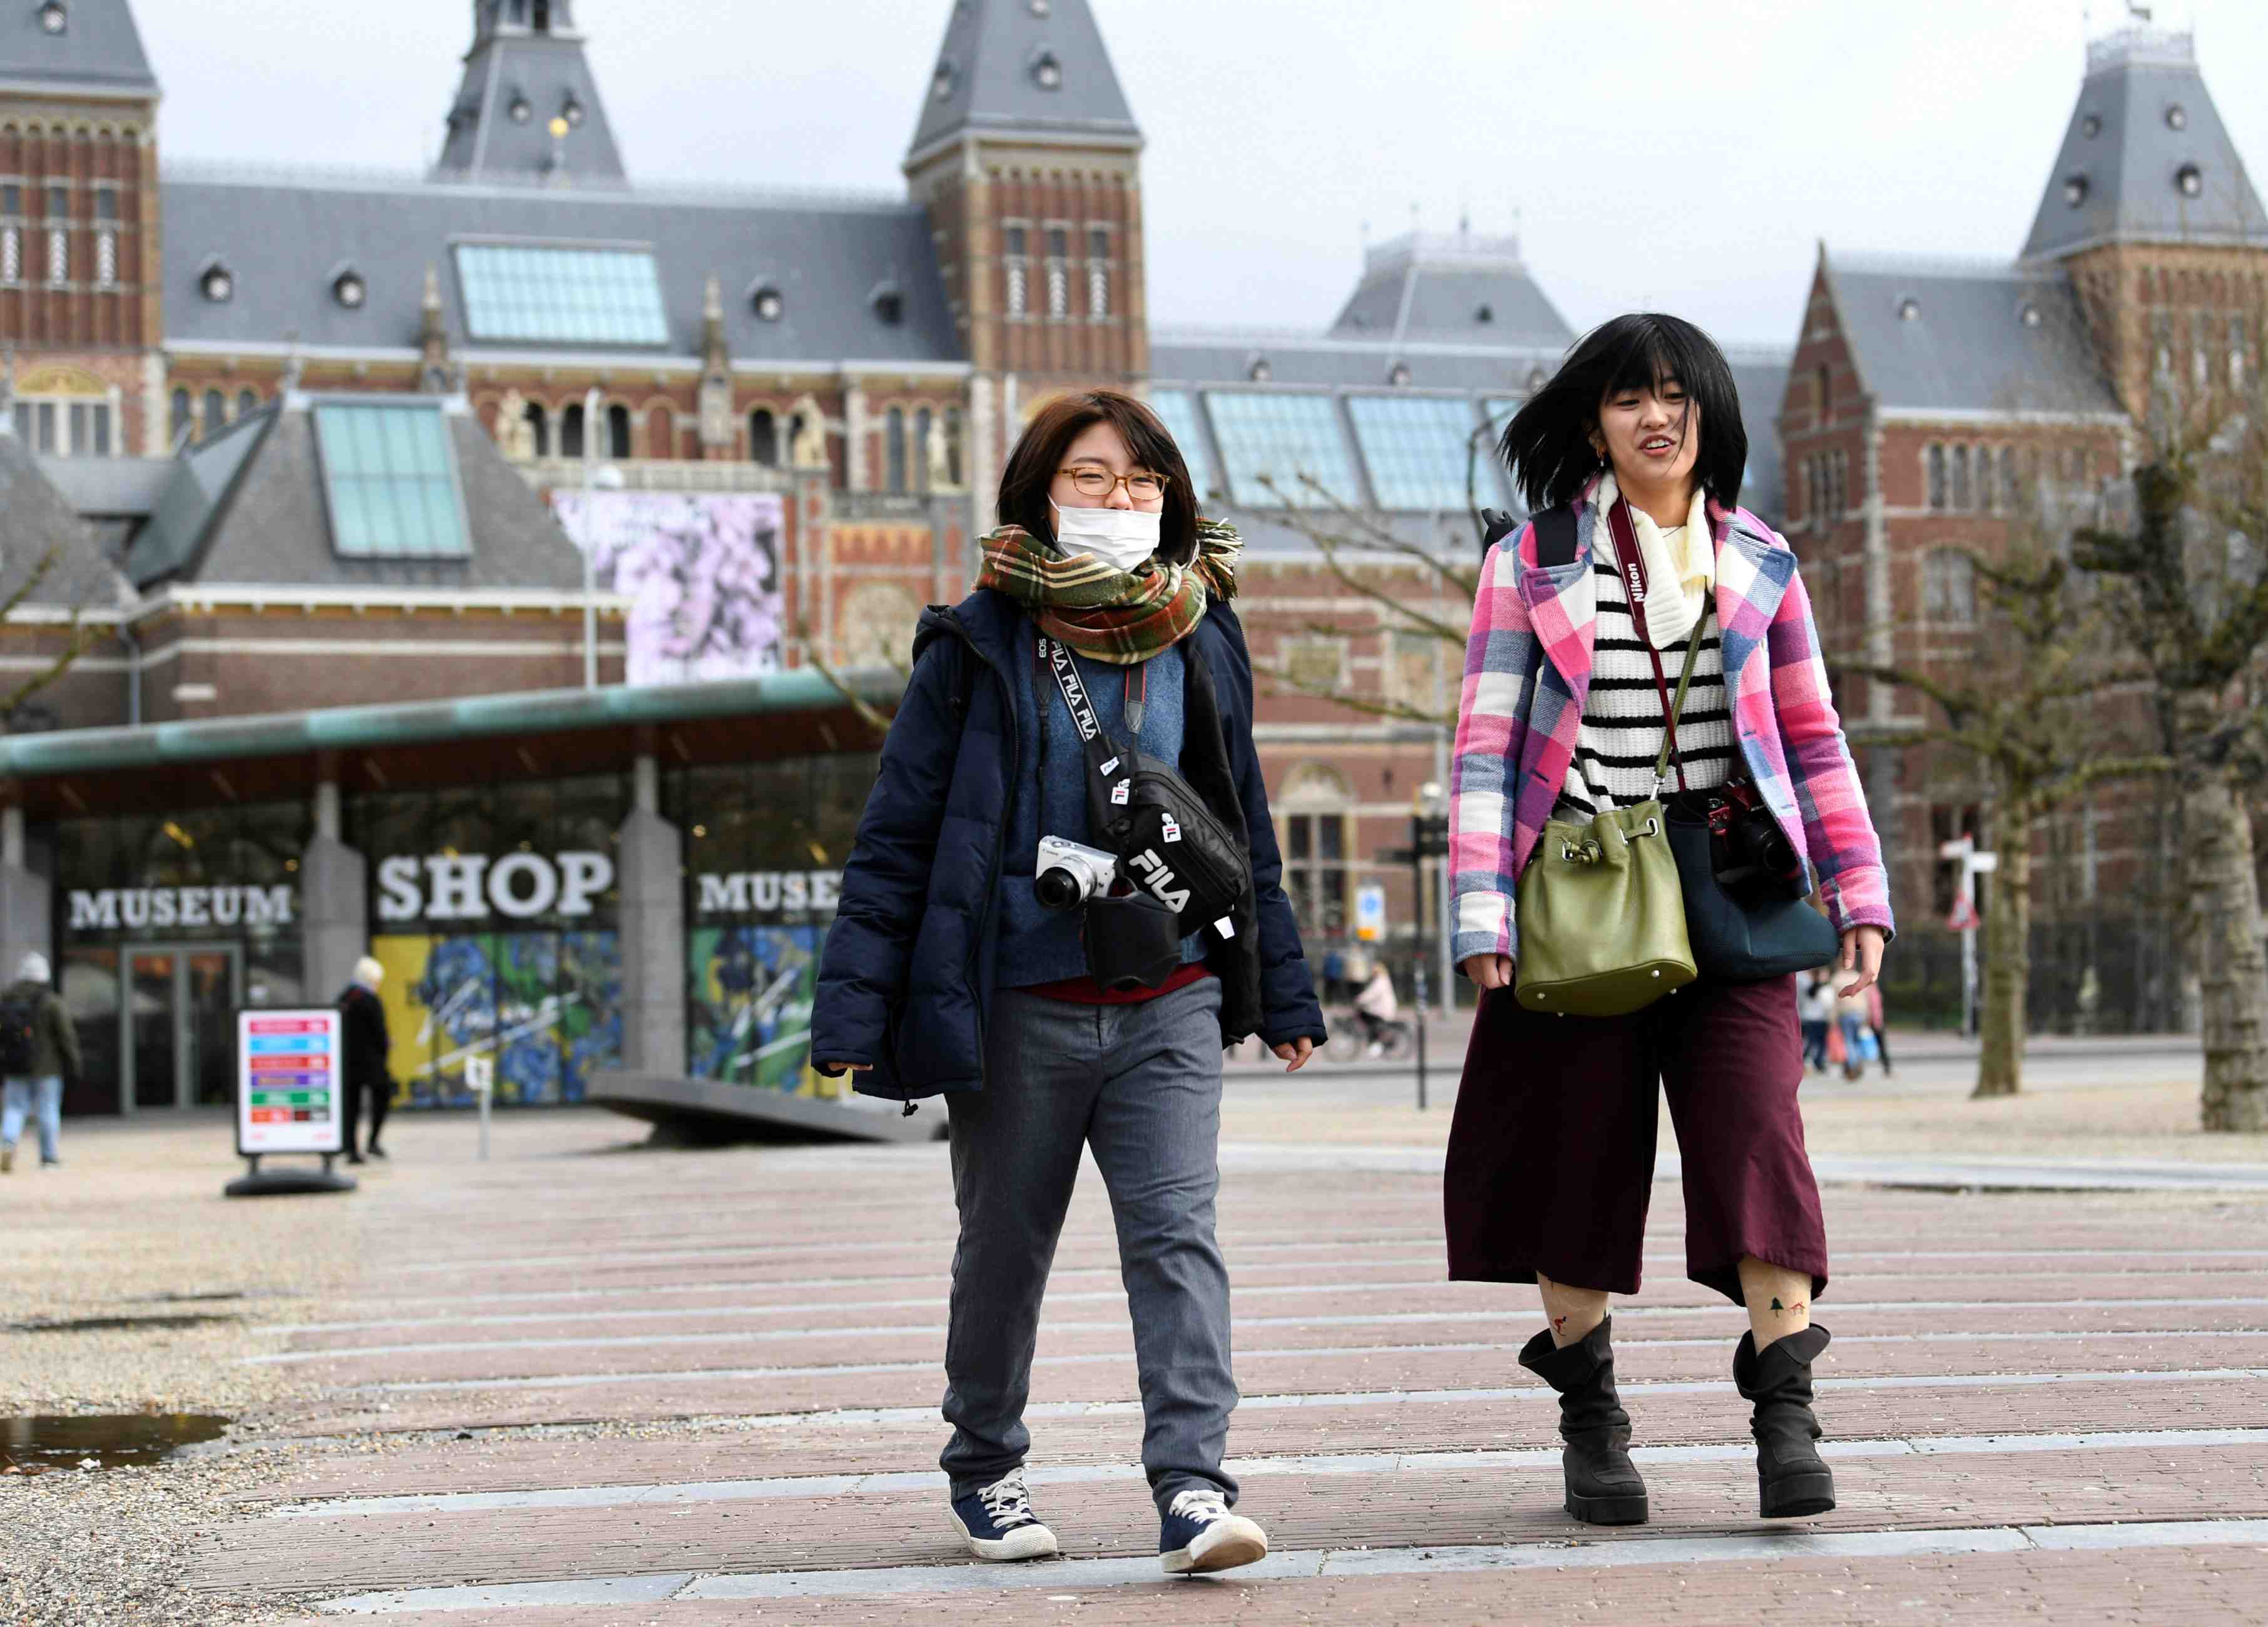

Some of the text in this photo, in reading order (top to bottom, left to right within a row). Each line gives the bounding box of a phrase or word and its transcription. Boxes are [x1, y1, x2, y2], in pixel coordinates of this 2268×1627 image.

[1628, 563, 1645, 602] Nikon
[1039, 638, 1047, 658] EOS
[1051, 641, 1097, 740] FILA FILA FILA
[69, 852, 613, 929] MUSEUM SHOP
[1128, 849, 1190, 914] FILA
